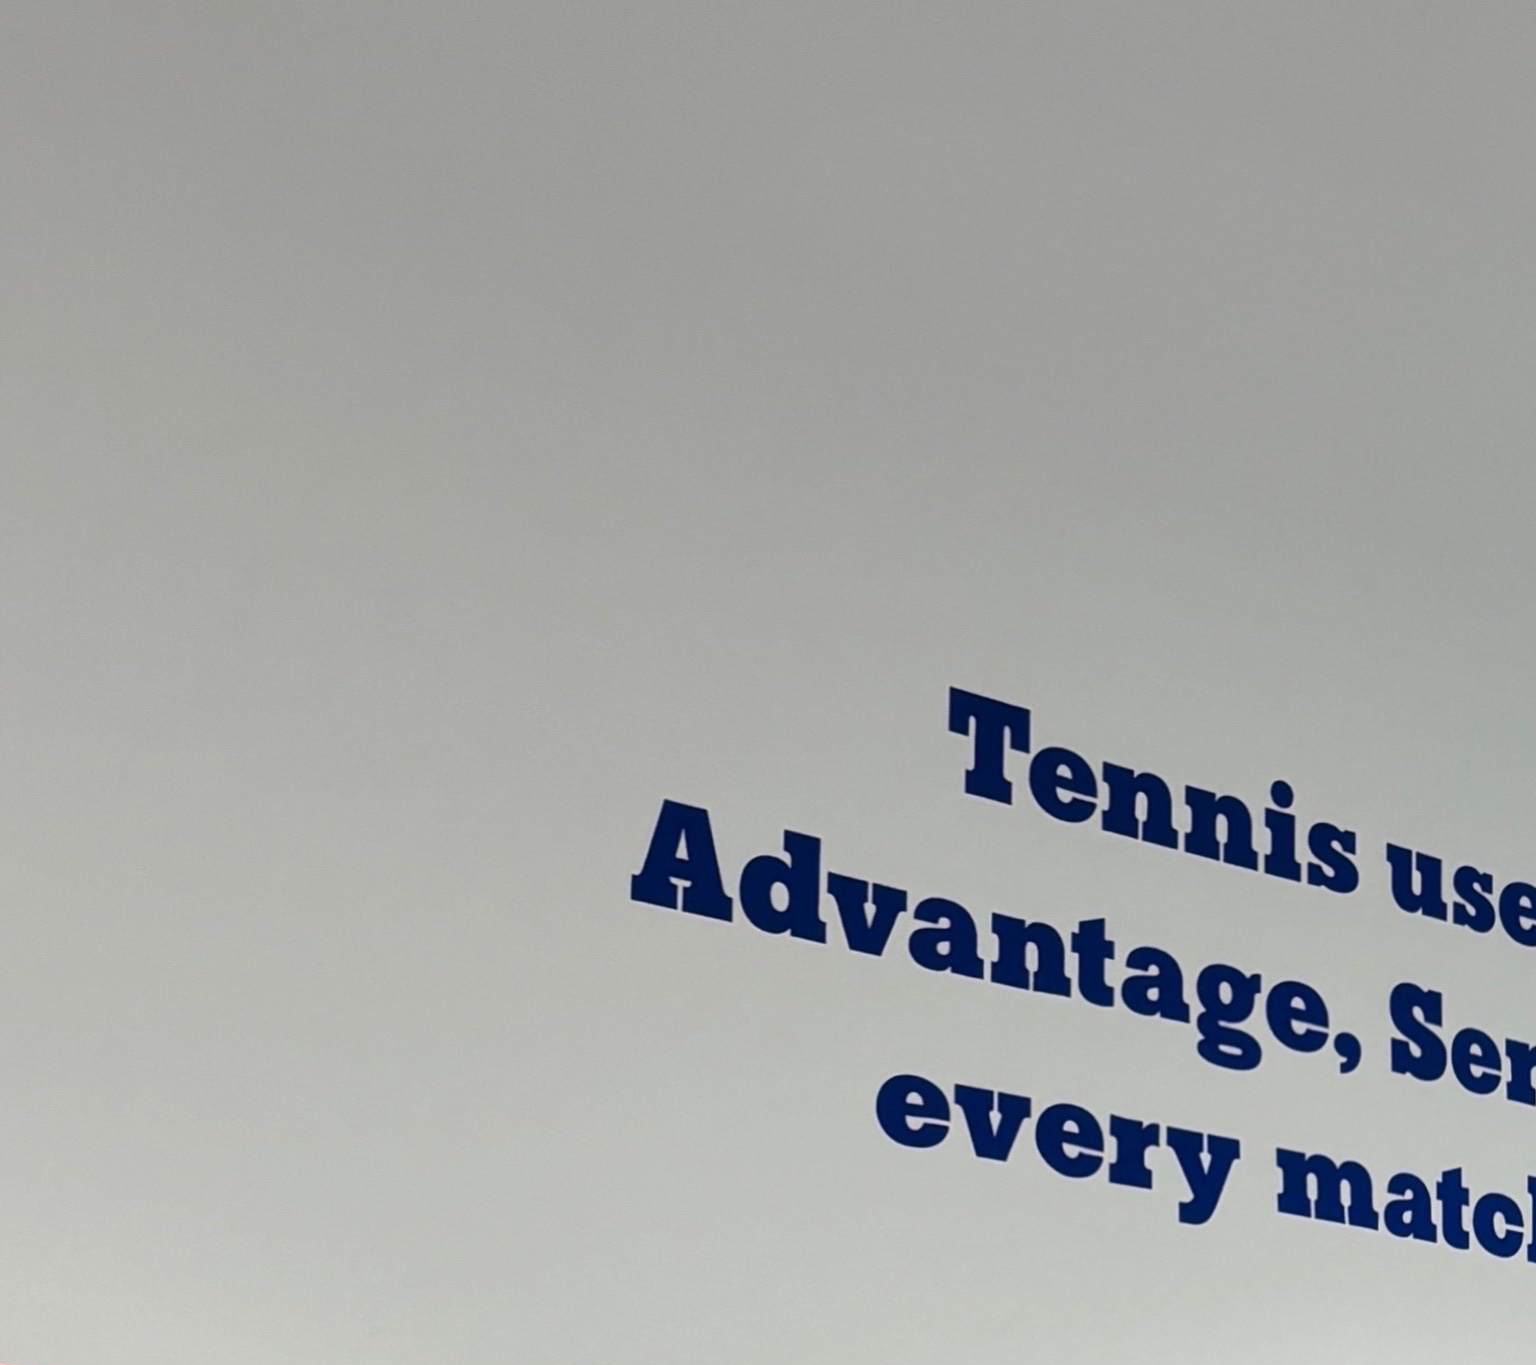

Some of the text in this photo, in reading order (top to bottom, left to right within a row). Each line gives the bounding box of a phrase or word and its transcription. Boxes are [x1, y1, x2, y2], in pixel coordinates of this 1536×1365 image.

[948, 688, 1360, 895] Tennis
[630, 800, 1362, 1072] Advantage,
[875, 1073, 1241, 1226] every
